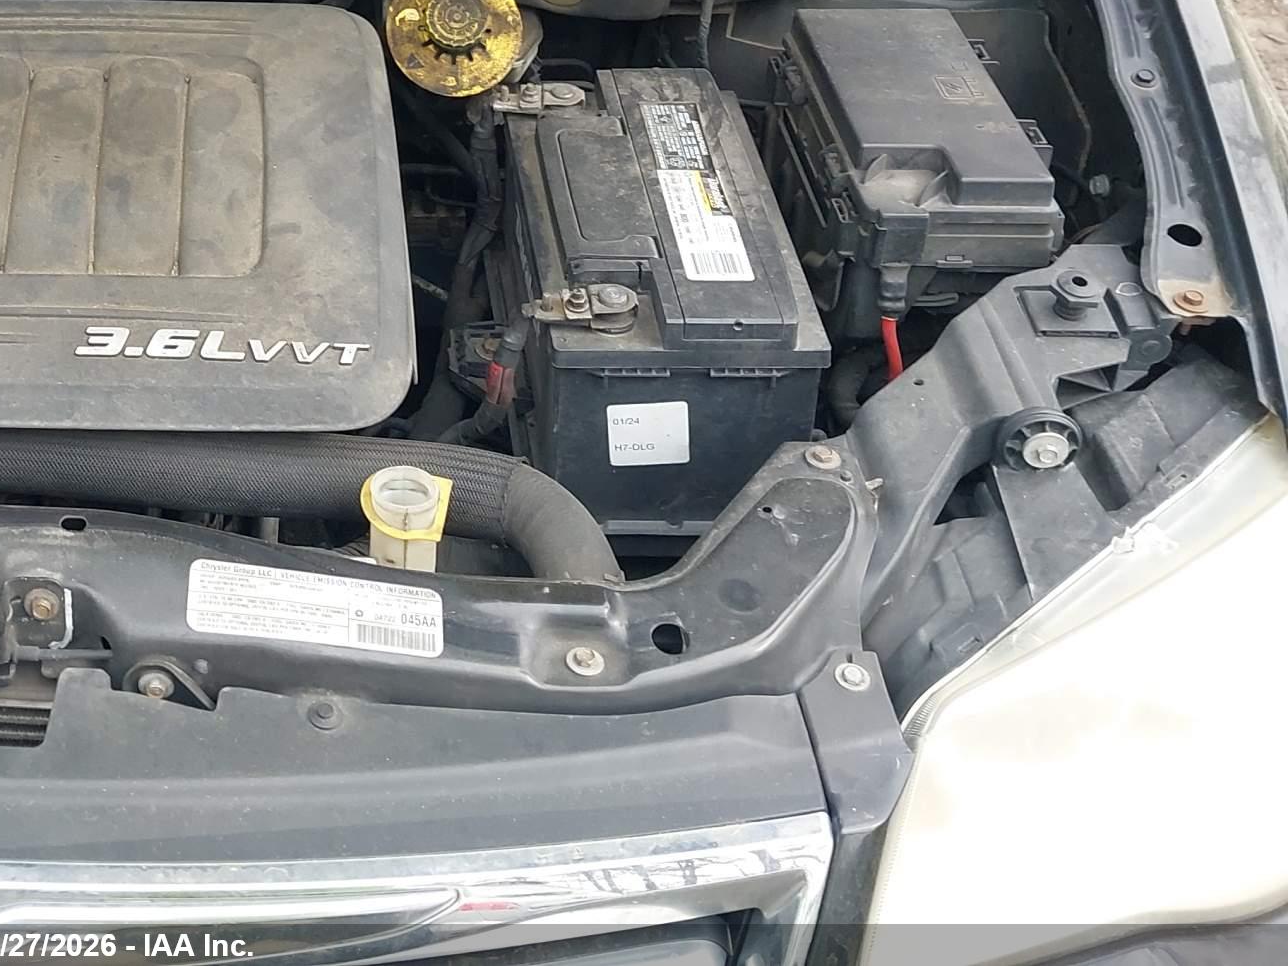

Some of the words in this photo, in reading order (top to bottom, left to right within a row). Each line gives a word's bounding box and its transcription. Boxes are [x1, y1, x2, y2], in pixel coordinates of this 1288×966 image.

[613, 417, 640, 426] 01/24
[614, 443, 655, 452] H7-DLG
[201, 561, 231, 572] Chrysler
[233, 566, 256, 576] Group
[258, 568, 273, 577] LLC
[313, 575, 347, 587] EMISSION
[350, 581, 383, 592] CONTROL
[386, 586, 437, 599] INFORMATION
[401, 613, 437, 627] 045AA
